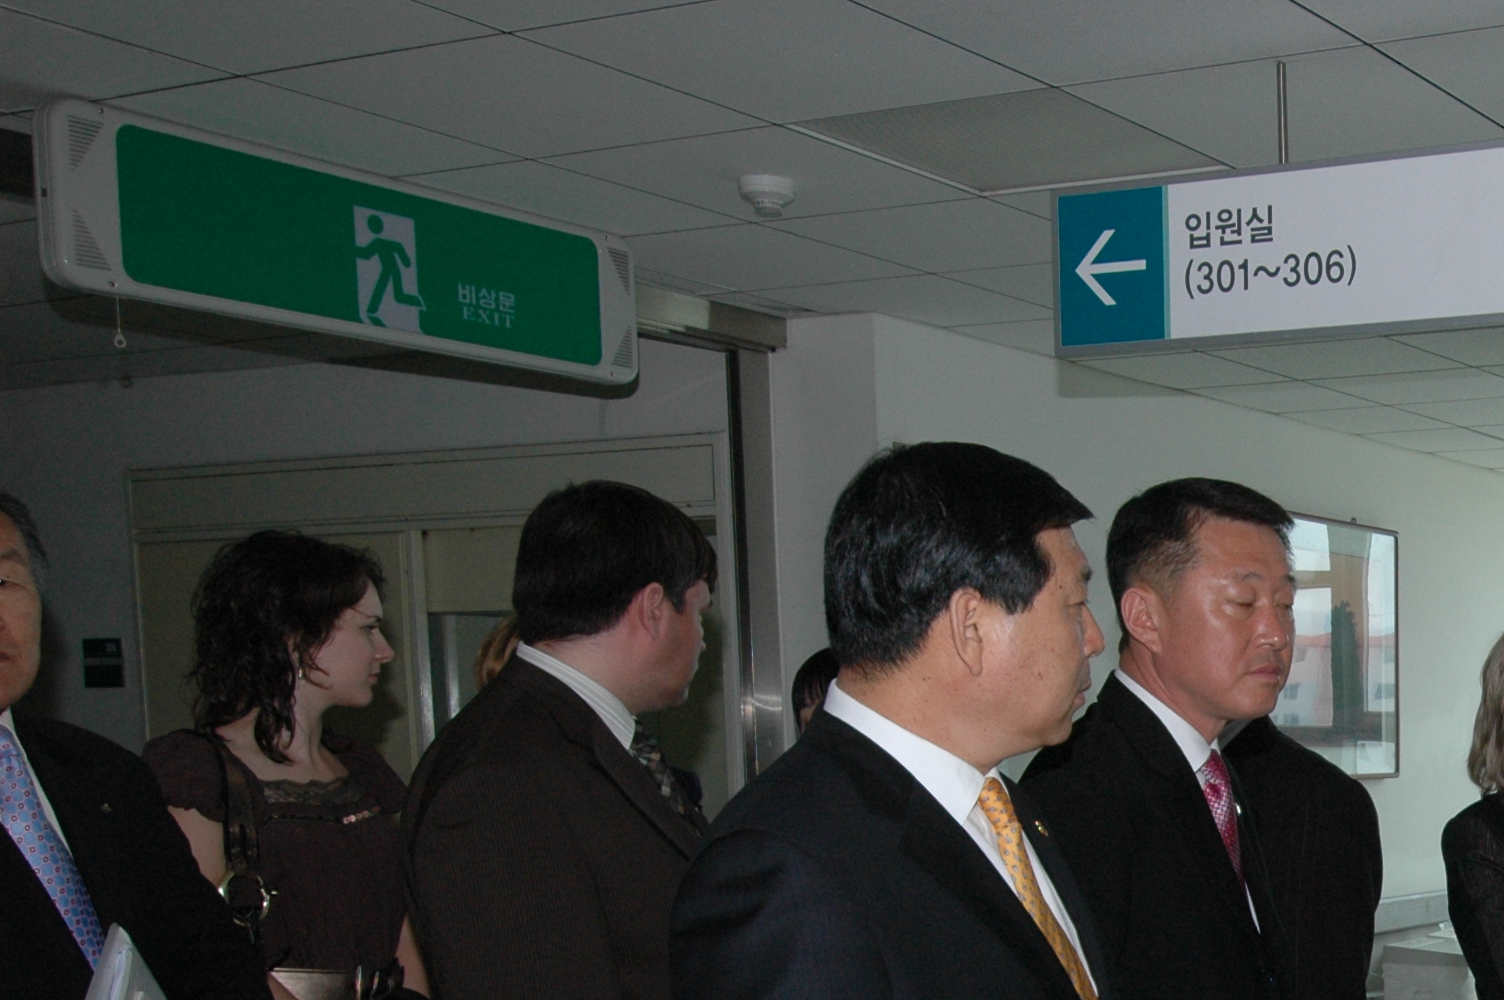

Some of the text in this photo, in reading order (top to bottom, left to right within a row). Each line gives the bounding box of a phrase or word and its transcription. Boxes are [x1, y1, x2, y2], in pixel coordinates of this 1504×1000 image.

[1184, 204, 1274, 250] 입원실
[1184, 244, 1357, 300] (301~306)
[457, 282, 516, 314] 비상문
[462, 305, 516, 329] EXIT
